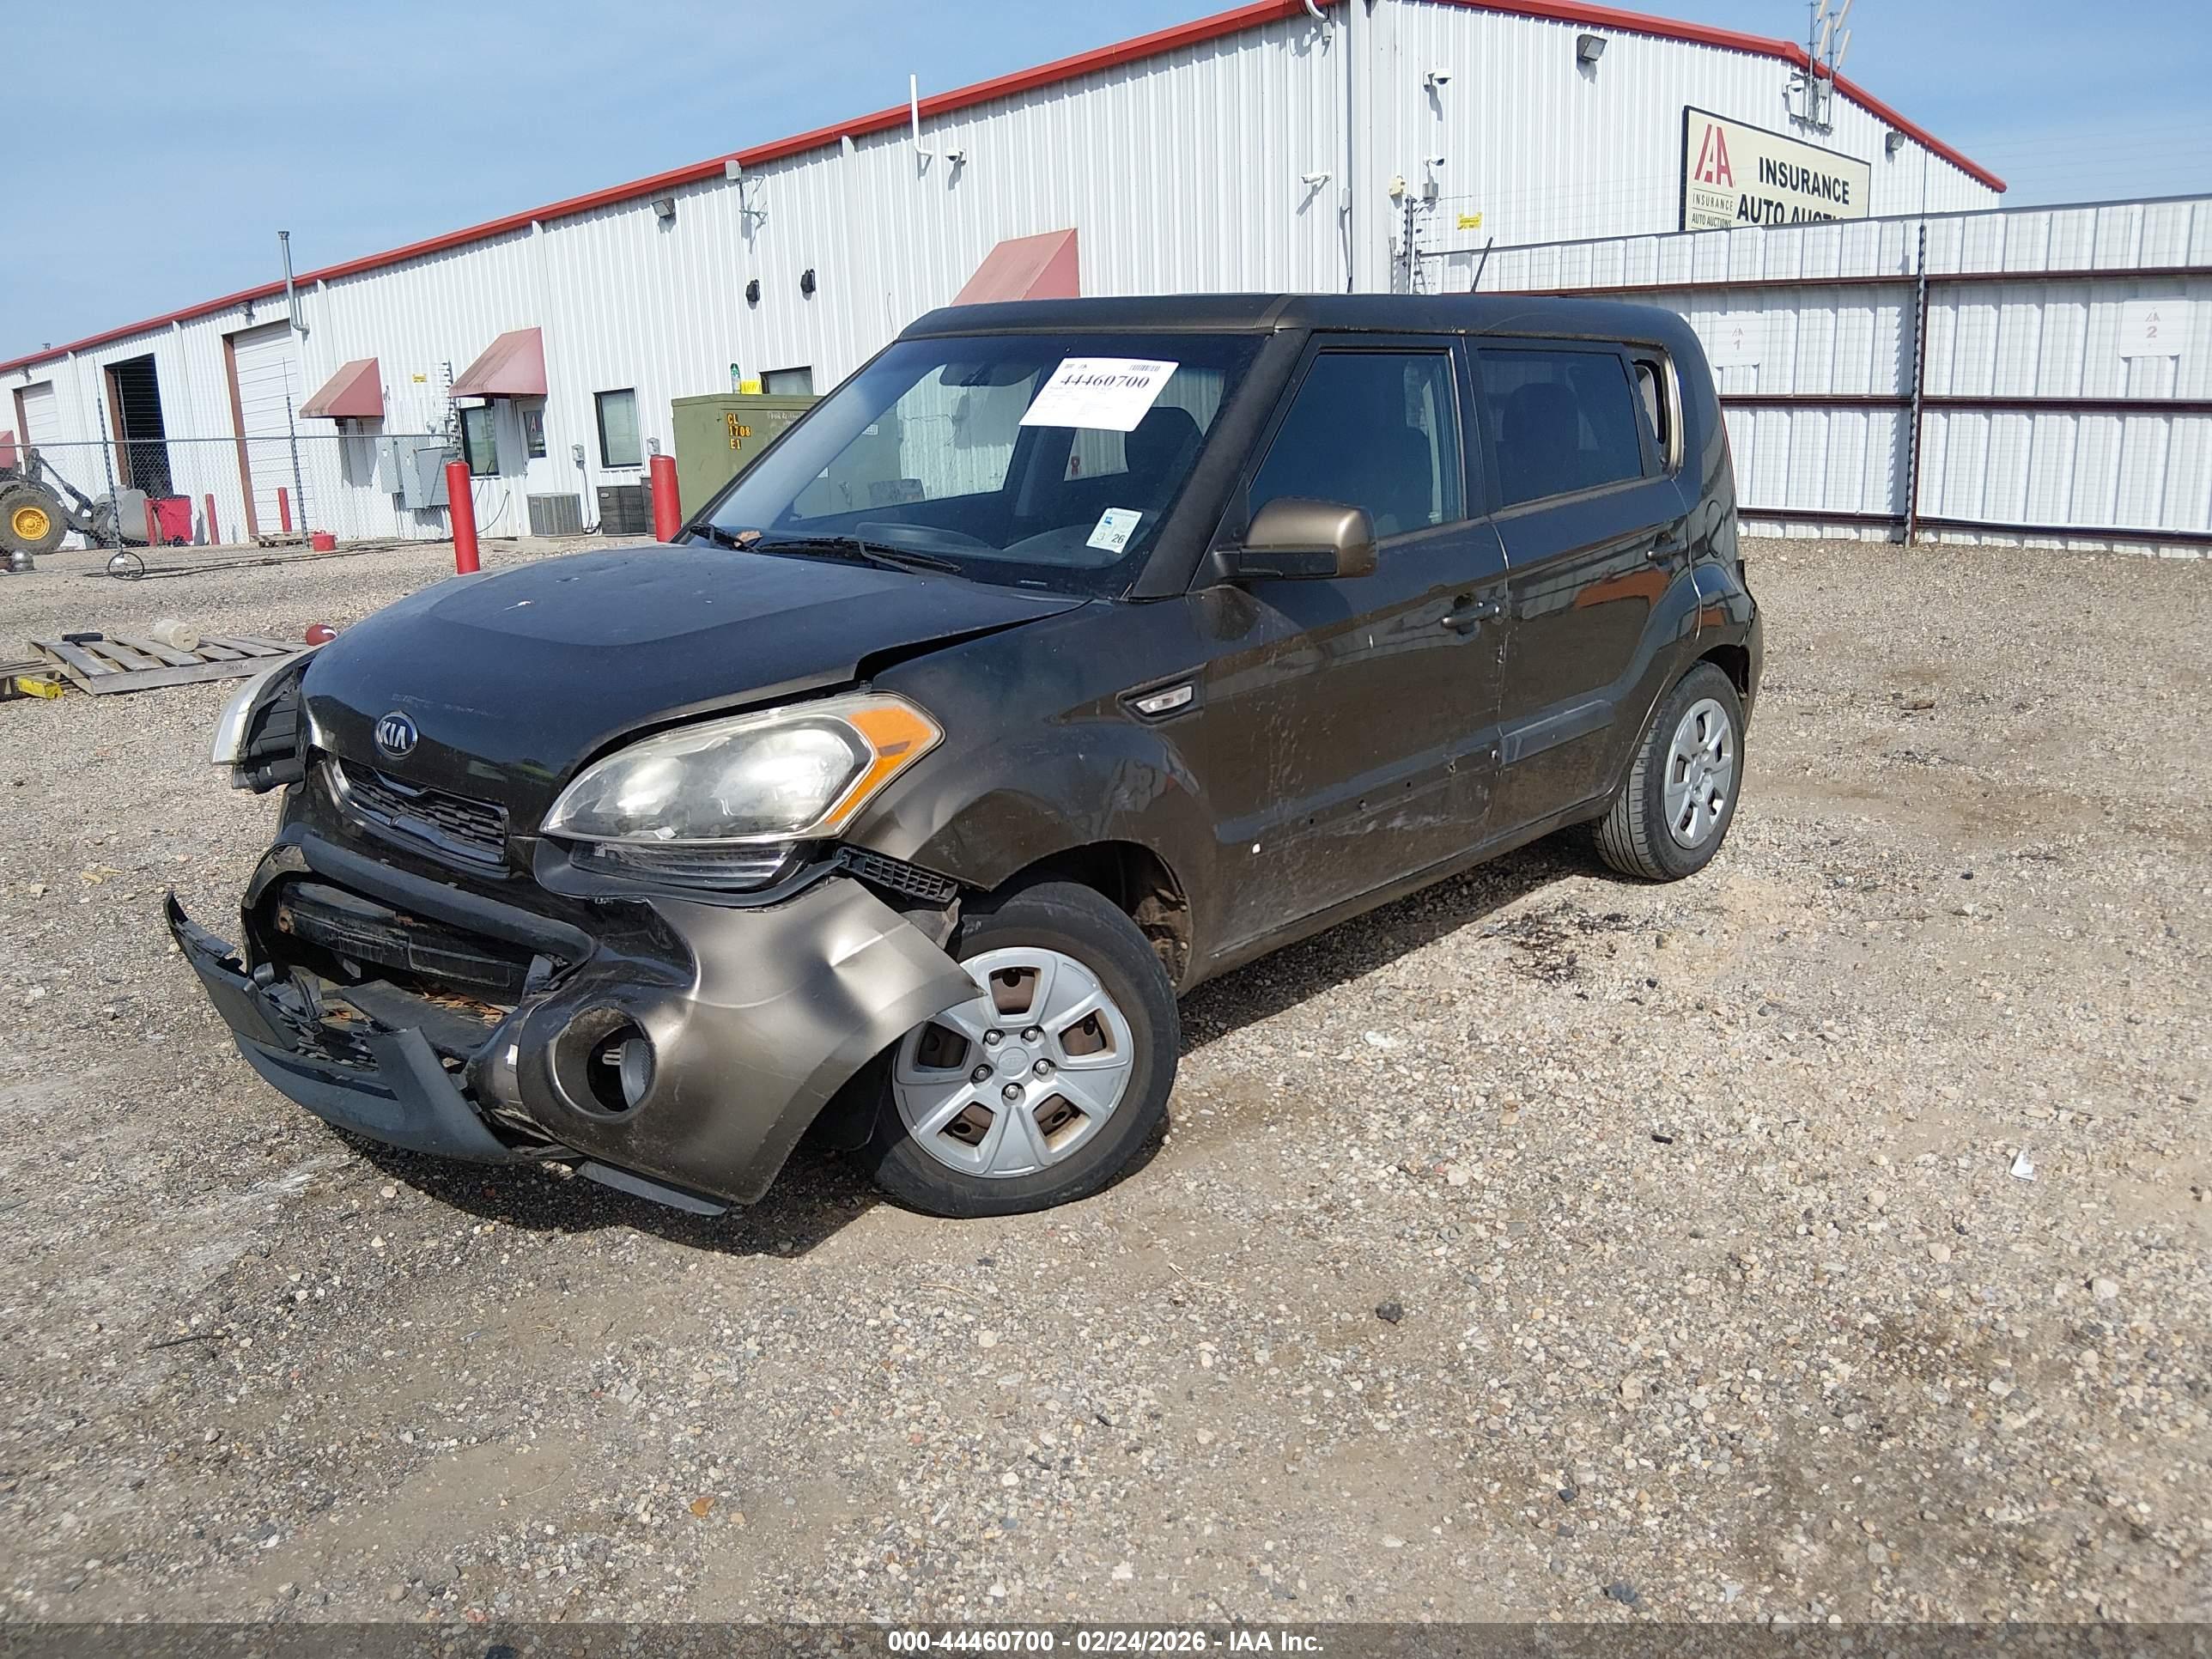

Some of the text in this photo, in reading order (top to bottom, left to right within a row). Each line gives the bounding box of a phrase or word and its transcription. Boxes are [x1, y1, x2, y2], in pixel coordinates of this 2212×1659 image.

[1759, 156, 1850, 205] INSURANCE
[1692, 193, 1733, 211] INSURANCE
[1736, 193, 1785, 224] AUTO
[1691, 213, 1732, 228] AUTO AUCTIONS
[2146, 325, 2158, 339] 2
[1060, 374, 1150, 389] 44460700
[727, 414, 738, 424] CL
[729, 426, 750, 436] 1708
[1111, 533, 1126, 544] 26
[380, 720, 407, 750] KIA
